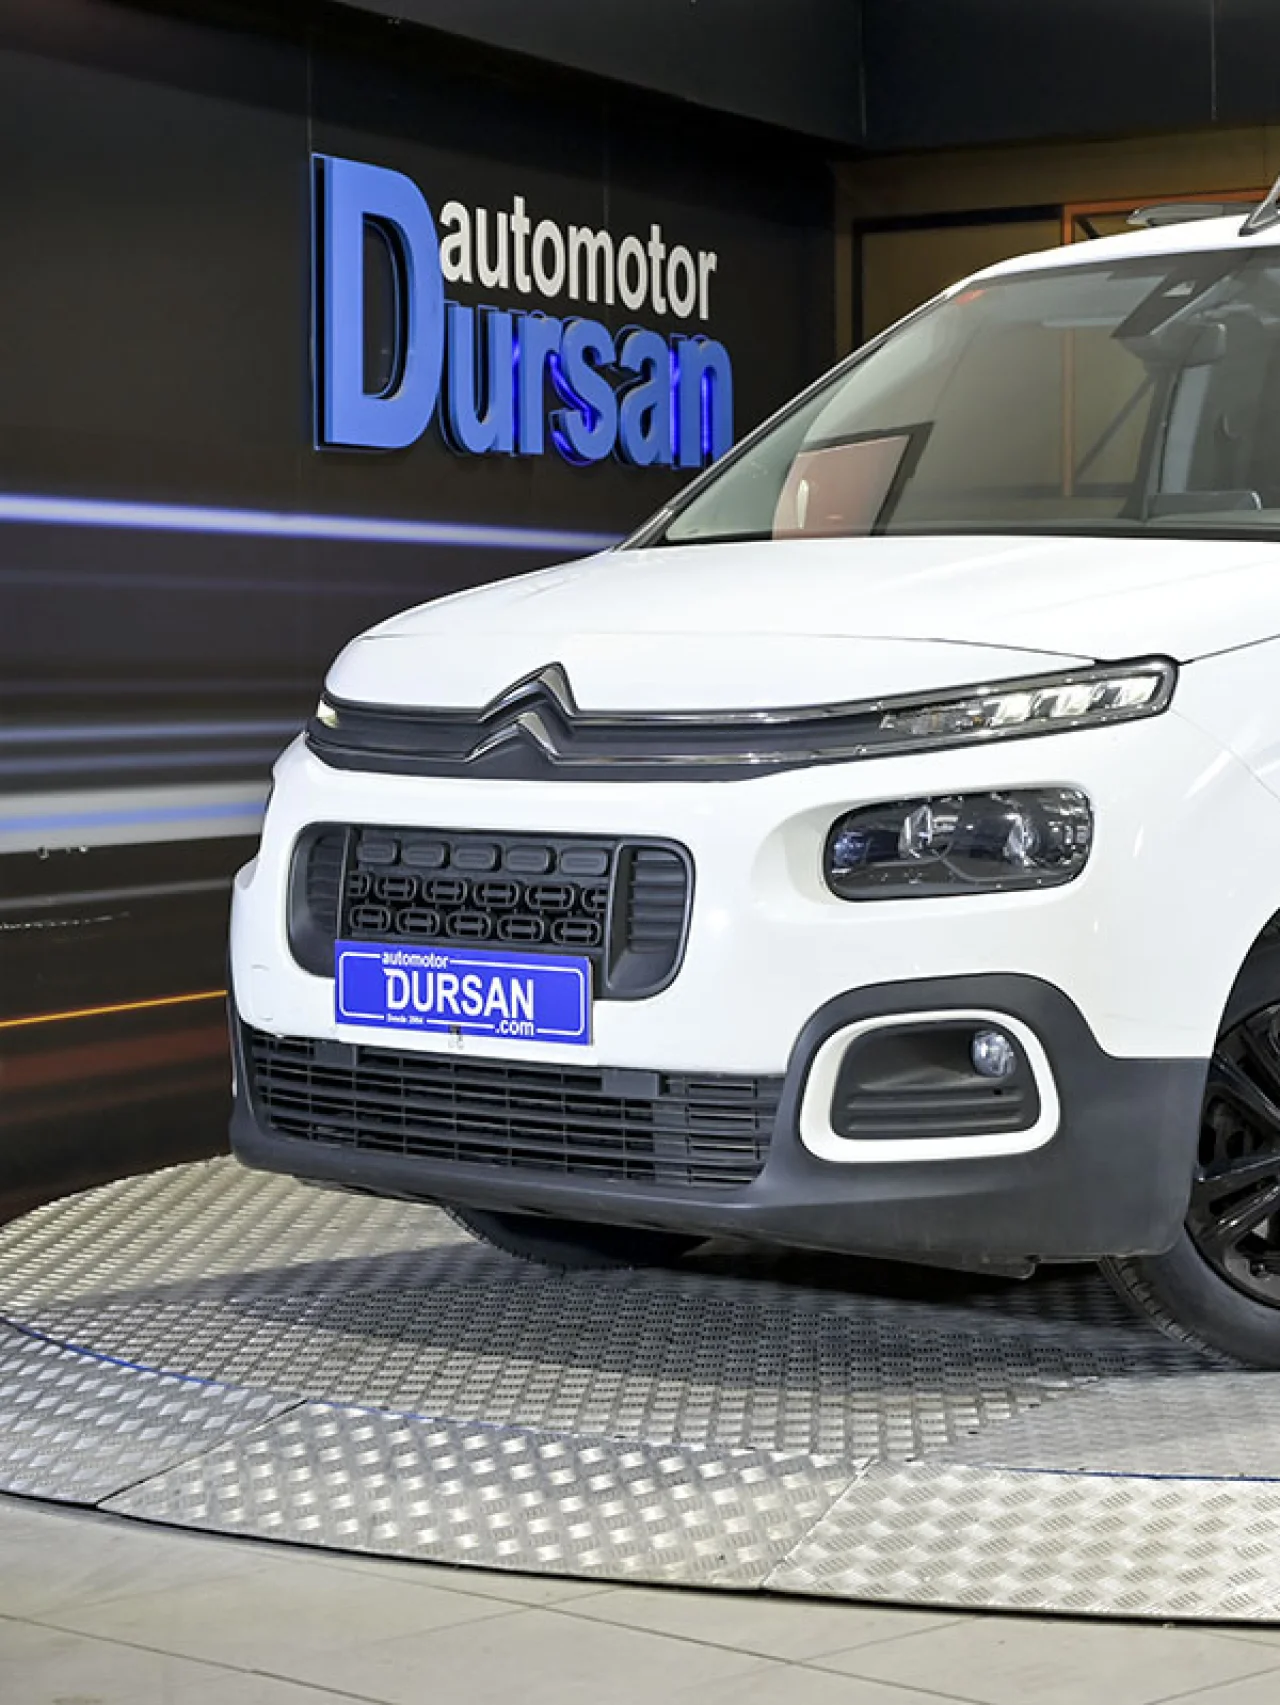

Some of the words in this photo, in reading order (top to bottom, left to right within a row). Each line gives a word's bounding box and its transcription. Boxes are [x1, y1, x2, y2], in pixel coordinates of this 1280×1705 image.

[439, 195, 718, 321] automotor
[312, 153, 734, 471] Dursan
[381, 950, 450, 969] automotor
[382, 967, 535, 1020] DURSAN
[494, 1018, 535, 1036] .com
